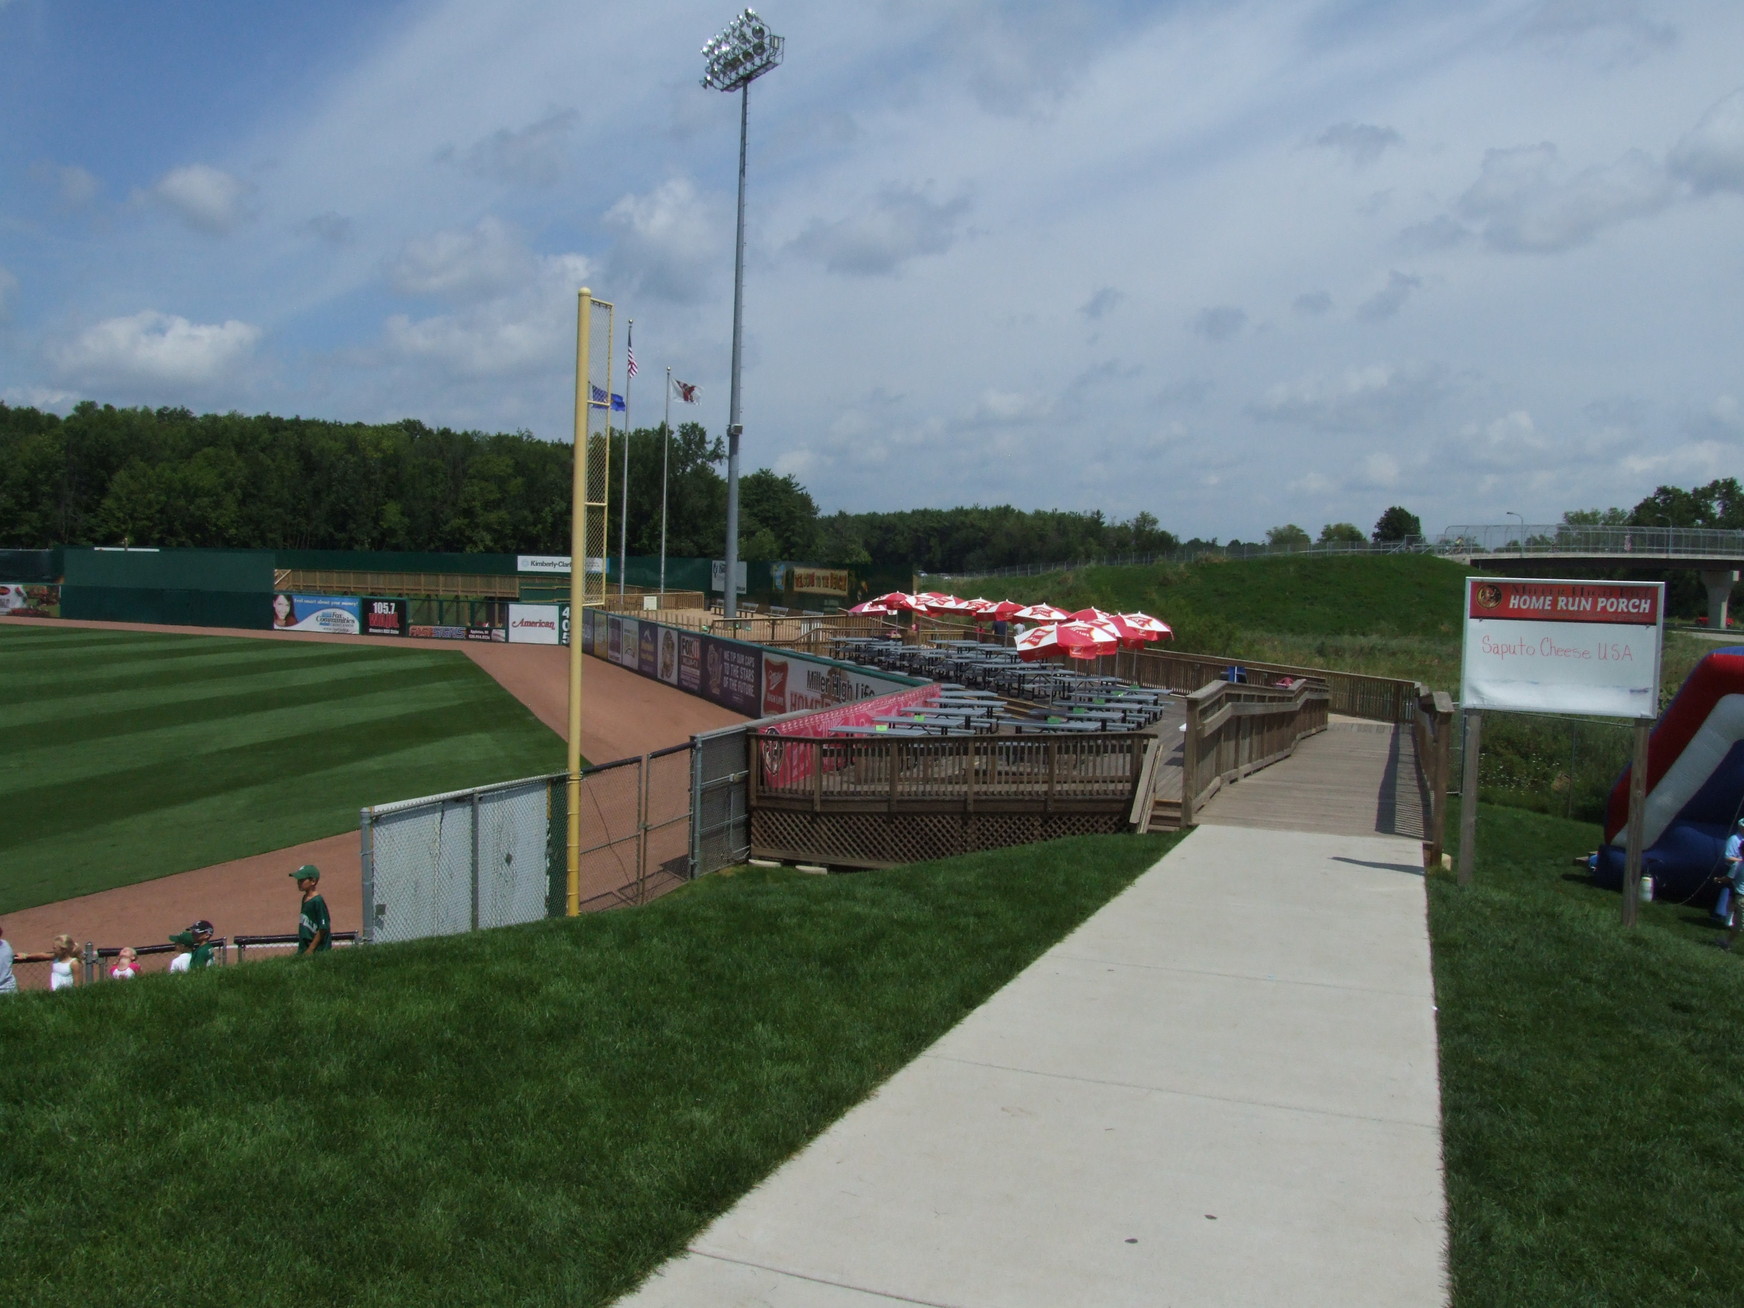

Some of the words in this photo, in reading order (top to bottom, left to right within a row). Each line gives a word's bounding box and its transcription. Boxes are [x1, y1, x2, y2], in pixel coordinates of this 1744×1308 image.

[373, 602, 396, 615] 105.7
[1509, 595, 1552, 610] HOME
[1556, 596, 1591, 611] RUN
[1597, 598, 1651, 613] PORCH
[316, 616, 355, 624] Communities
[511, 618, 556, 631] American
[1481, 635, 1536, 660] Saputo
[1539, 637, 1592, 660] Cheese
[1598, 642, 1633, 661] USA
[745, 655, 755, 668] CAPS
[723, 662, 730, 675] TO
[730, 664, 739, 678] THE
[739, 667, 755, 683] STARS
[723, 676, 729, 688] OF
[729, 677, 737, 691] THE
[806, 670, 830, 693] Miller
[832, 672, 851, 703] High
[855, 683, 875, 700] Life
